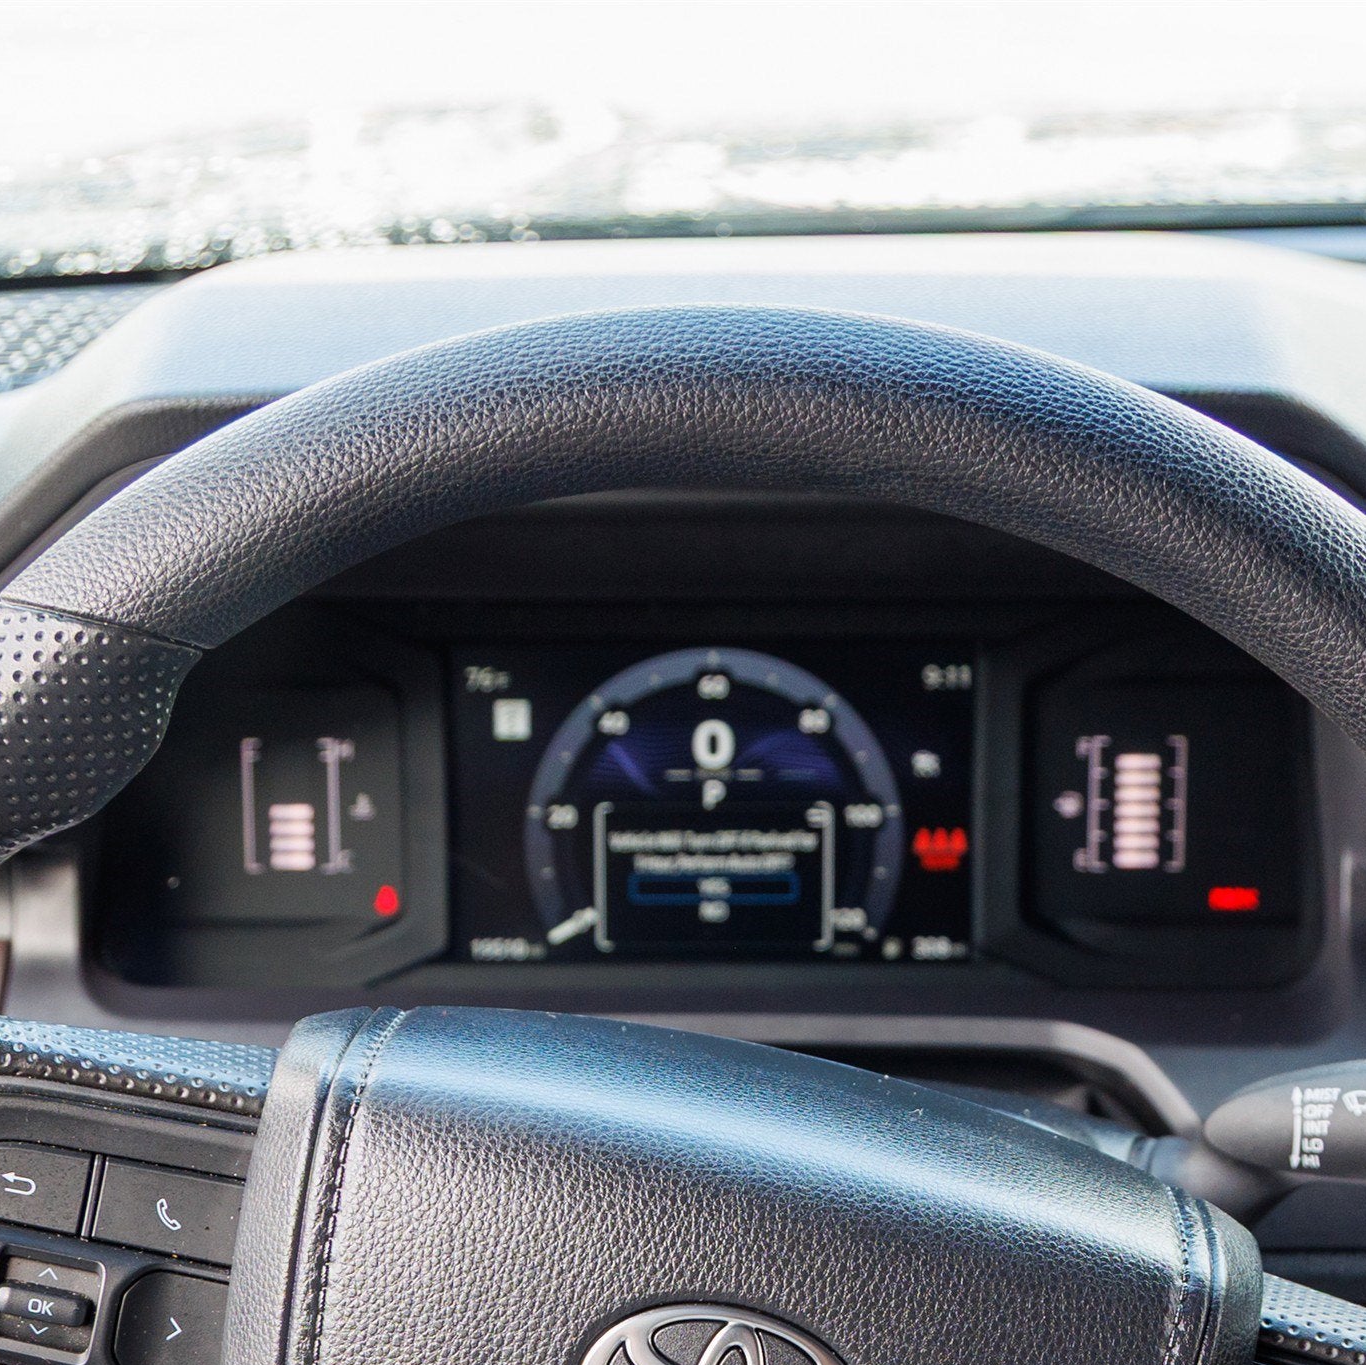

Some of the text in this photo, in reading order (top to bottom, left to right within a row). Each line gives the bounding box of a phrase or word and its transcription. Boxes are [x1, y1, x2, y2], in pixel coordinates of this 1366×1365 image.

[697, 674, 731, 700] 60
[691, 718, 736, 770] 0
[1303, 1087, 1342, 1104] MIST
[1302, 1103, 1335, 1120] OFF
[1302, 1119, 1331, 1137] INT
[1301, 1137, 1325, 1154] LO
[1301, 1153, 1321, 1170] HI
[27, 1298, 55, 1317] OK
